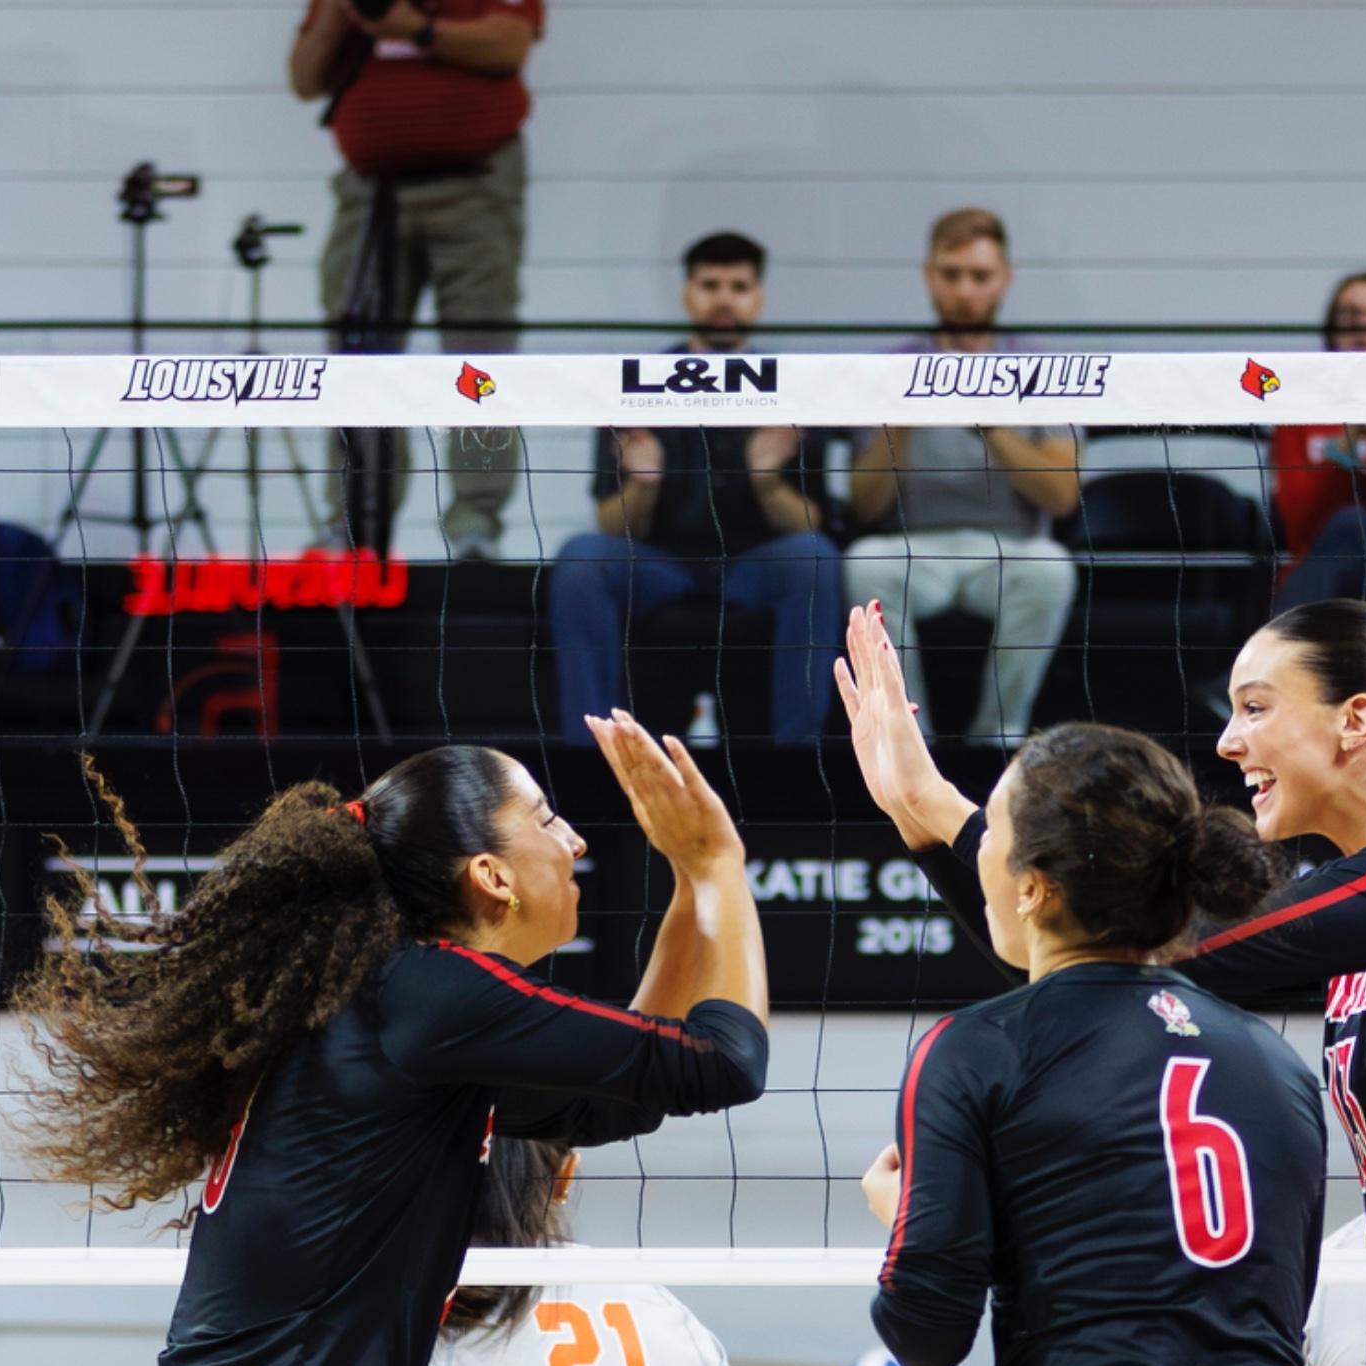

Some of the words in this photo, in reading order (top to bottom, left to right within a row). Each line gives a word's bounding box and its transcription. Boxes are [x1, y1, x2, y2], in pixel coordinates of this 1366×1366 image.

[121, 359, 327, 406] LOUISVILLE
[622, 357, 777, 394] L&N
[903, 356, 1111, 403] LOUISVILLE
[620, 397, 680, 408] FEDERAL
[684, 397, 732, 408] CREDIT
[735, 397, 778, 408] UNION
[745, 859, 871, 902] KATIE
[1160, 1056, 1255, 1269] 6
